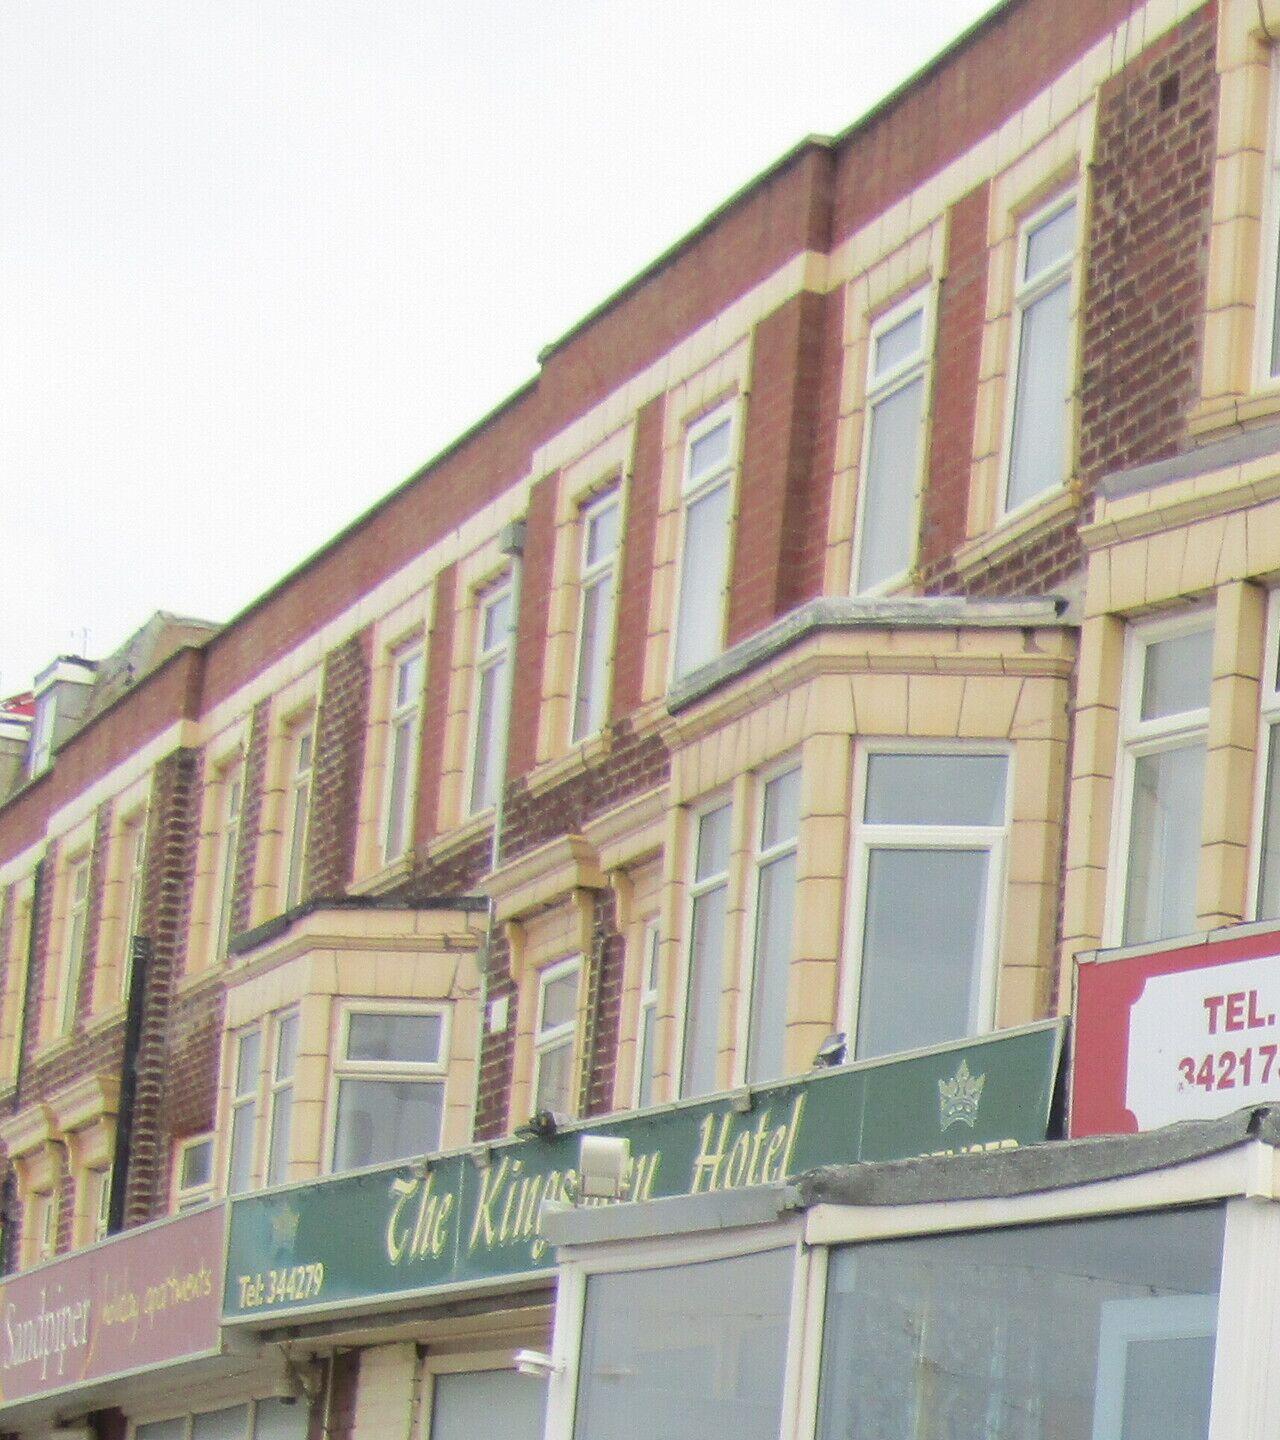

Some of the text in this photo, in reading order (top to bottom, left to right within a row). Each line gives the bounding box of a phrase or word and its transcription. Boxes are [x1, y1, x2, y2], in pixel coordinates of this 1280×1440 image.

[1203, 989, 1276, 1036] TEL.
[386, 1170, 453, 1266] The
[691, 1090, 808, 1195] Hotel
